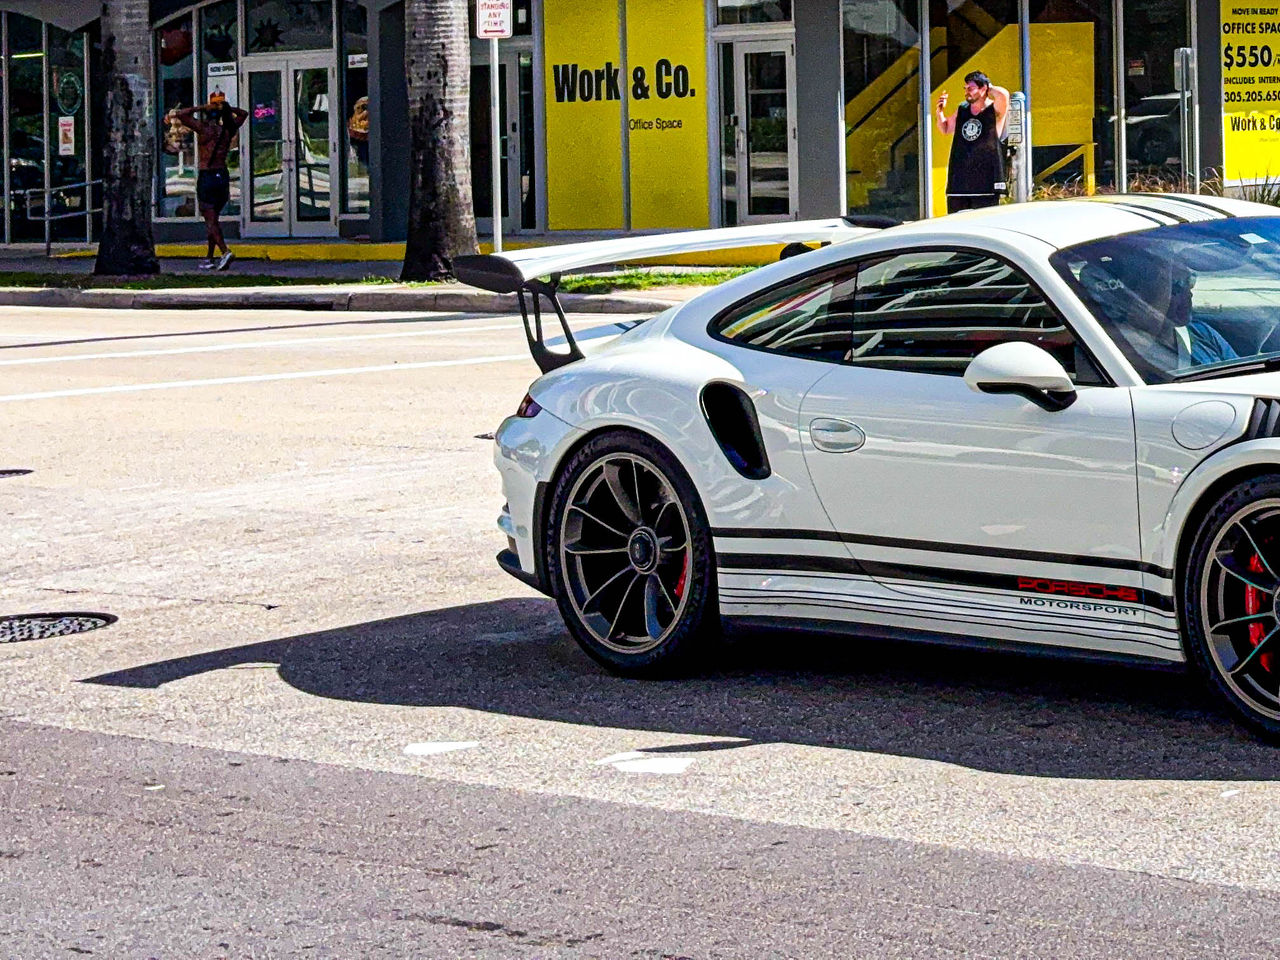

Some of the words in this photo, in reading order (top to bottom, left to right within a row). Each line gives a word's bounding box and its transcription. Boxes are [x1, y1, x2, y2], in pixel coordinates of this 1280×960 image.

[488, 11, 501, 19] ANY
[1223, 22, 1256, 34] OFFICE
[1224, 43, 1272, 71] $550
[553, 62, 621, 103] Work
[632, 66, 650, 100] &
[655, 58, 696, 99] Co.
[1224, 77, 1255, 85] INCLUDES
[629, 119, 653, 130] Office
[656, 118, 682, 131] Space
[1231, 116, 1257, 131] Work
[1260, 118, 1267, 130] &
[1017, 576, 1139, 602] PORSCHE
[1019, 597, 1140, 616] MOTORSPORT
